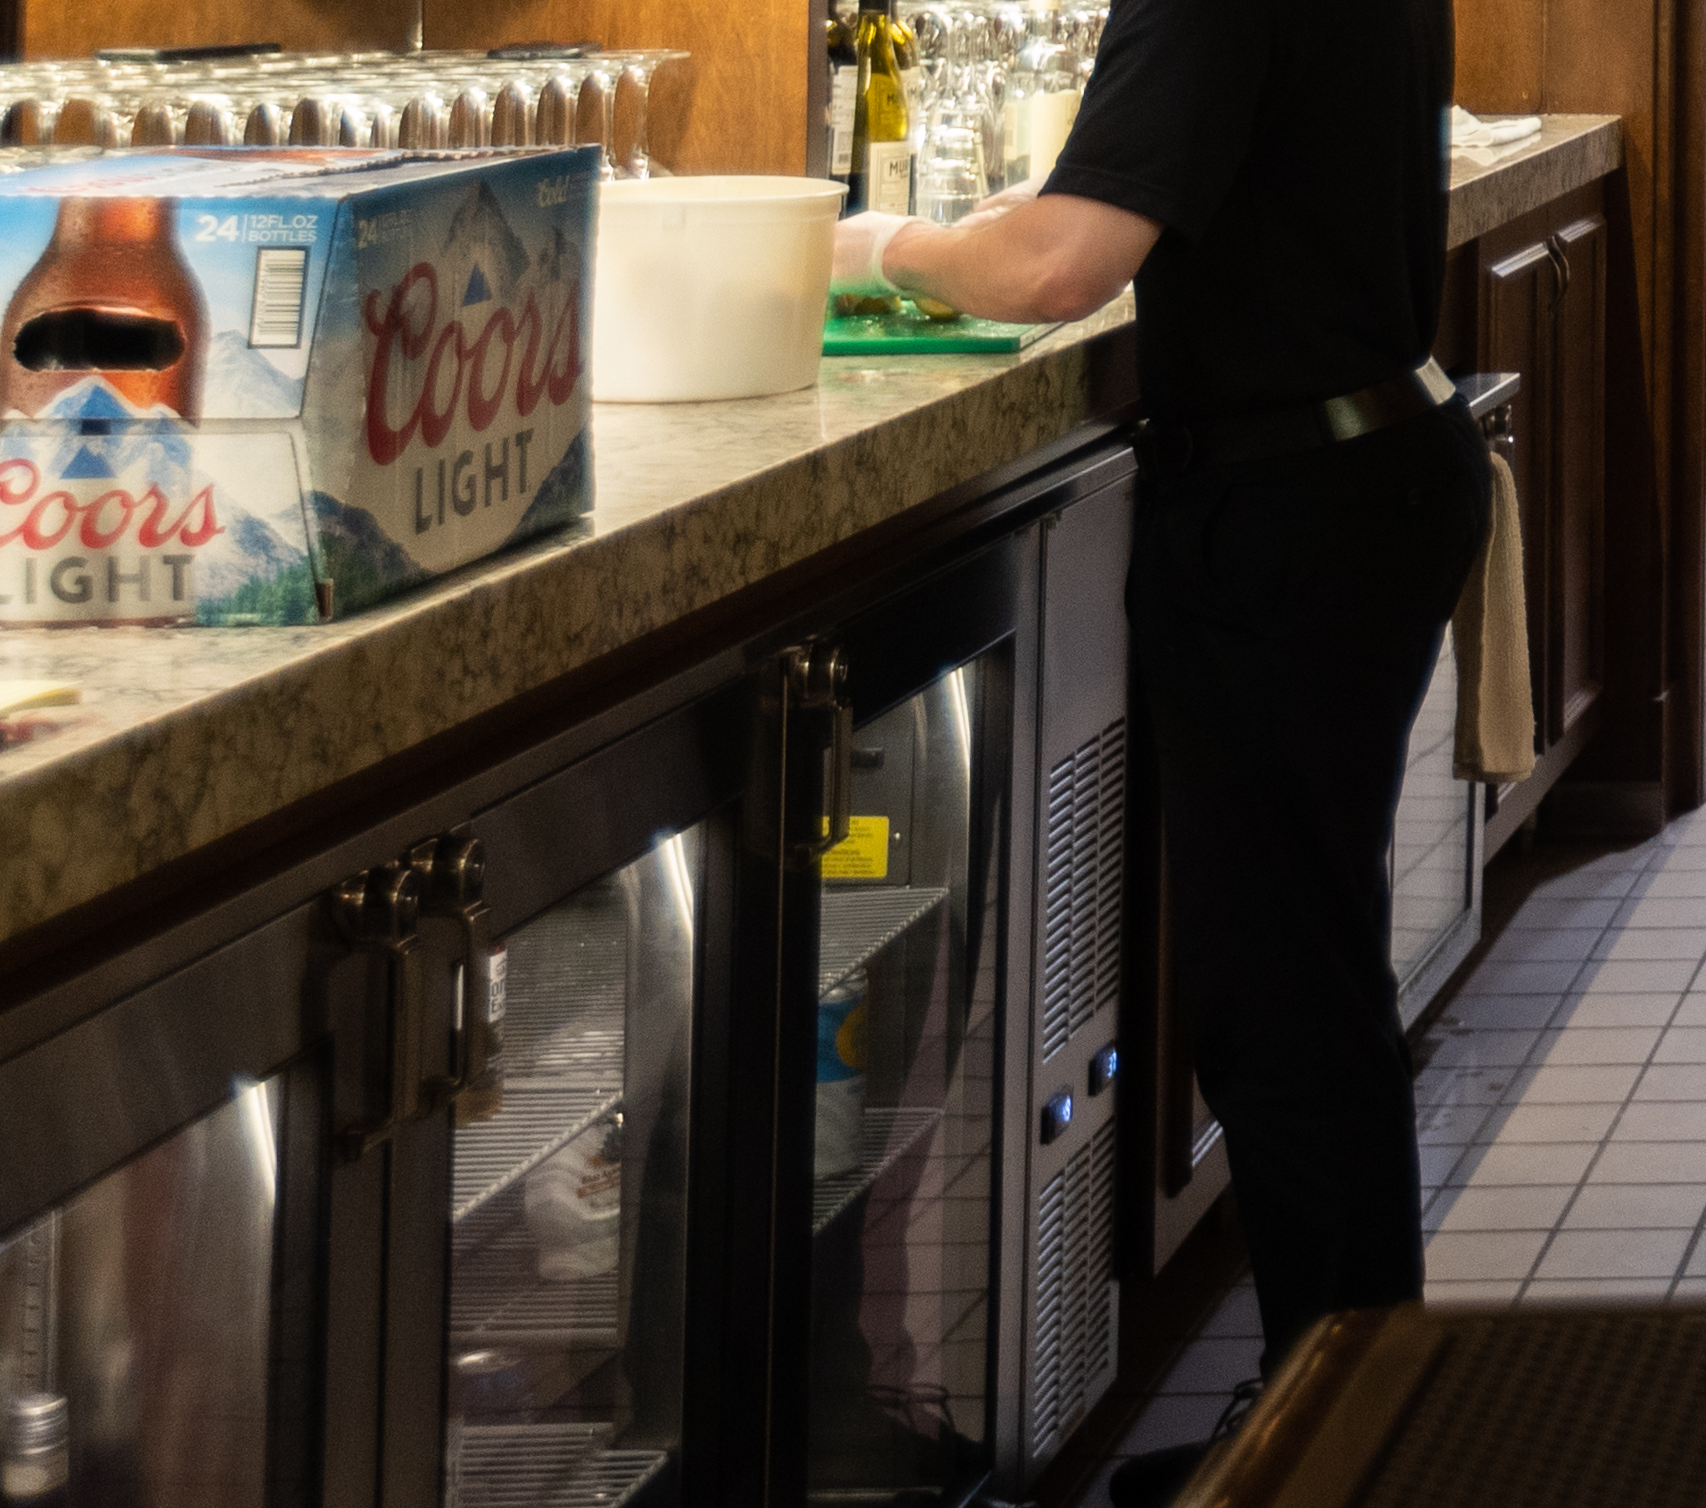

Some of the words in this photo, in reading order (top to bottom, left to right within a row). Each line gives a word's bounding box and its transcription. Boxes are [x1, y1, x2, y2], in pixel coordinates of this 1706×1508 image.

[195, 214, 239, 242] 24
[250, 214, 319, 229] 12FL.OZ
[248, 230, 317, 242] BOTTLES
[363, 261, 582, 466] Coors
[414, 427, 534, 536] LIGHT
[0, 554, 195, 605] IGHT
